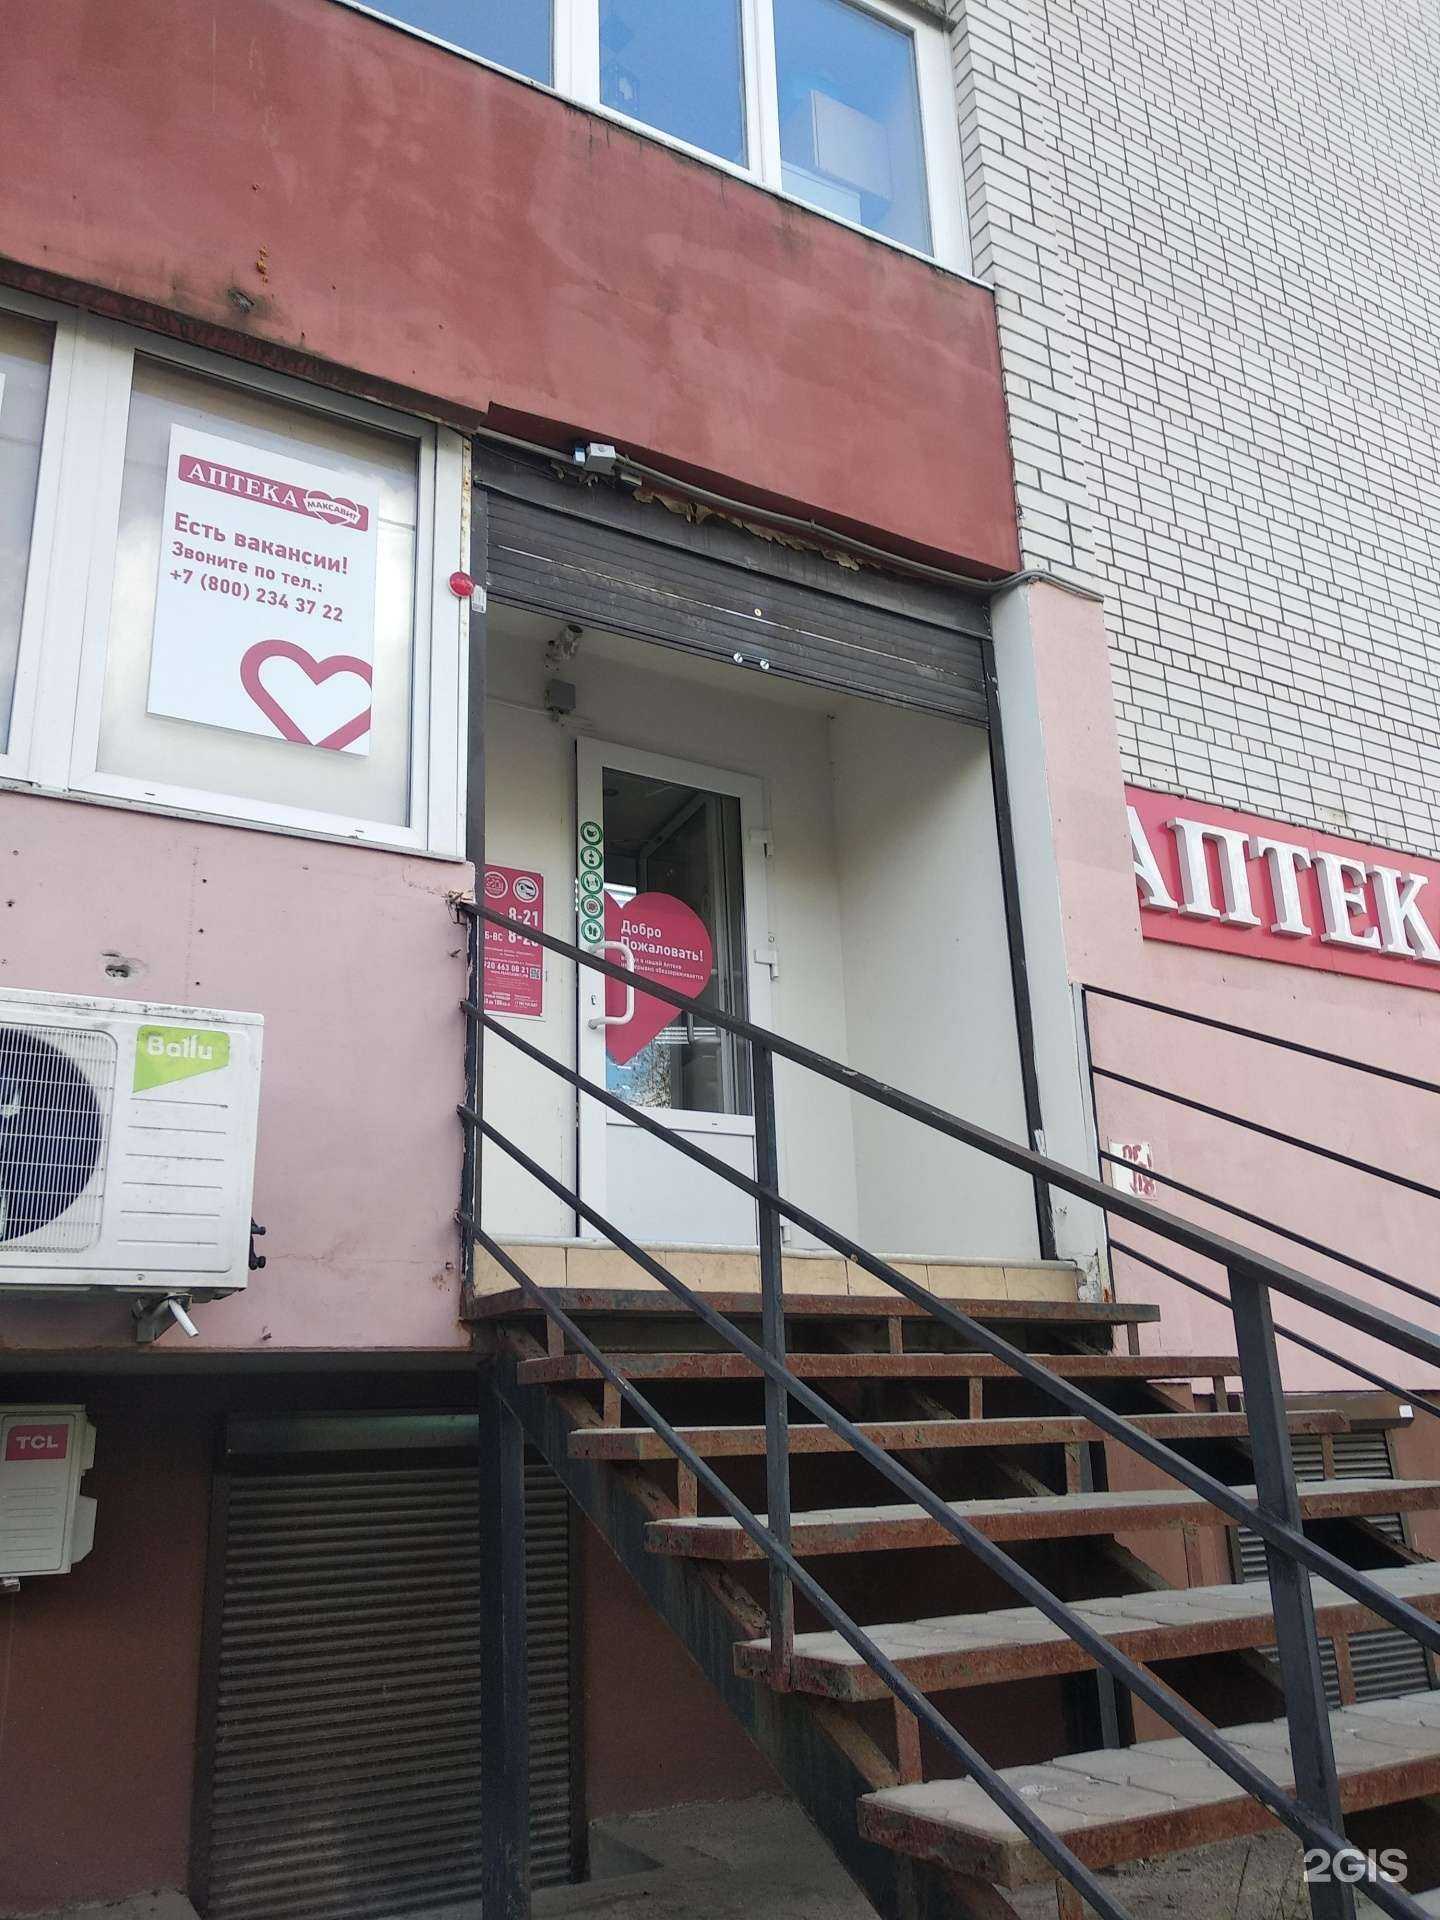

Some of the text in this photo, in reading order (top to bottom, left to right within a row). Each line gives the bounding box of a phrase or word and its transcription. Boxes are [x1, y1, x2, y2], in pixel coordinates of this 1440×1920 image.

[188, 463, 299, 508] АПТЕКА
[307, 501, 358, 521] МАКСАВИТ
[174, 511, 348, 575] Есть вакансии!
[171, 541, 323, 592] Звоните по тел.:
[170, 568, 343, 622] +7 (800) 234 37 22
[508, 907, 538, 927] 8-21
[620, 919, 662, 939] Добро
[620, 936, 703, 962] Пожаловать!
[147, 1034, 212, 1060] Ballu
[16, 1435, 58, 1449] TCL
